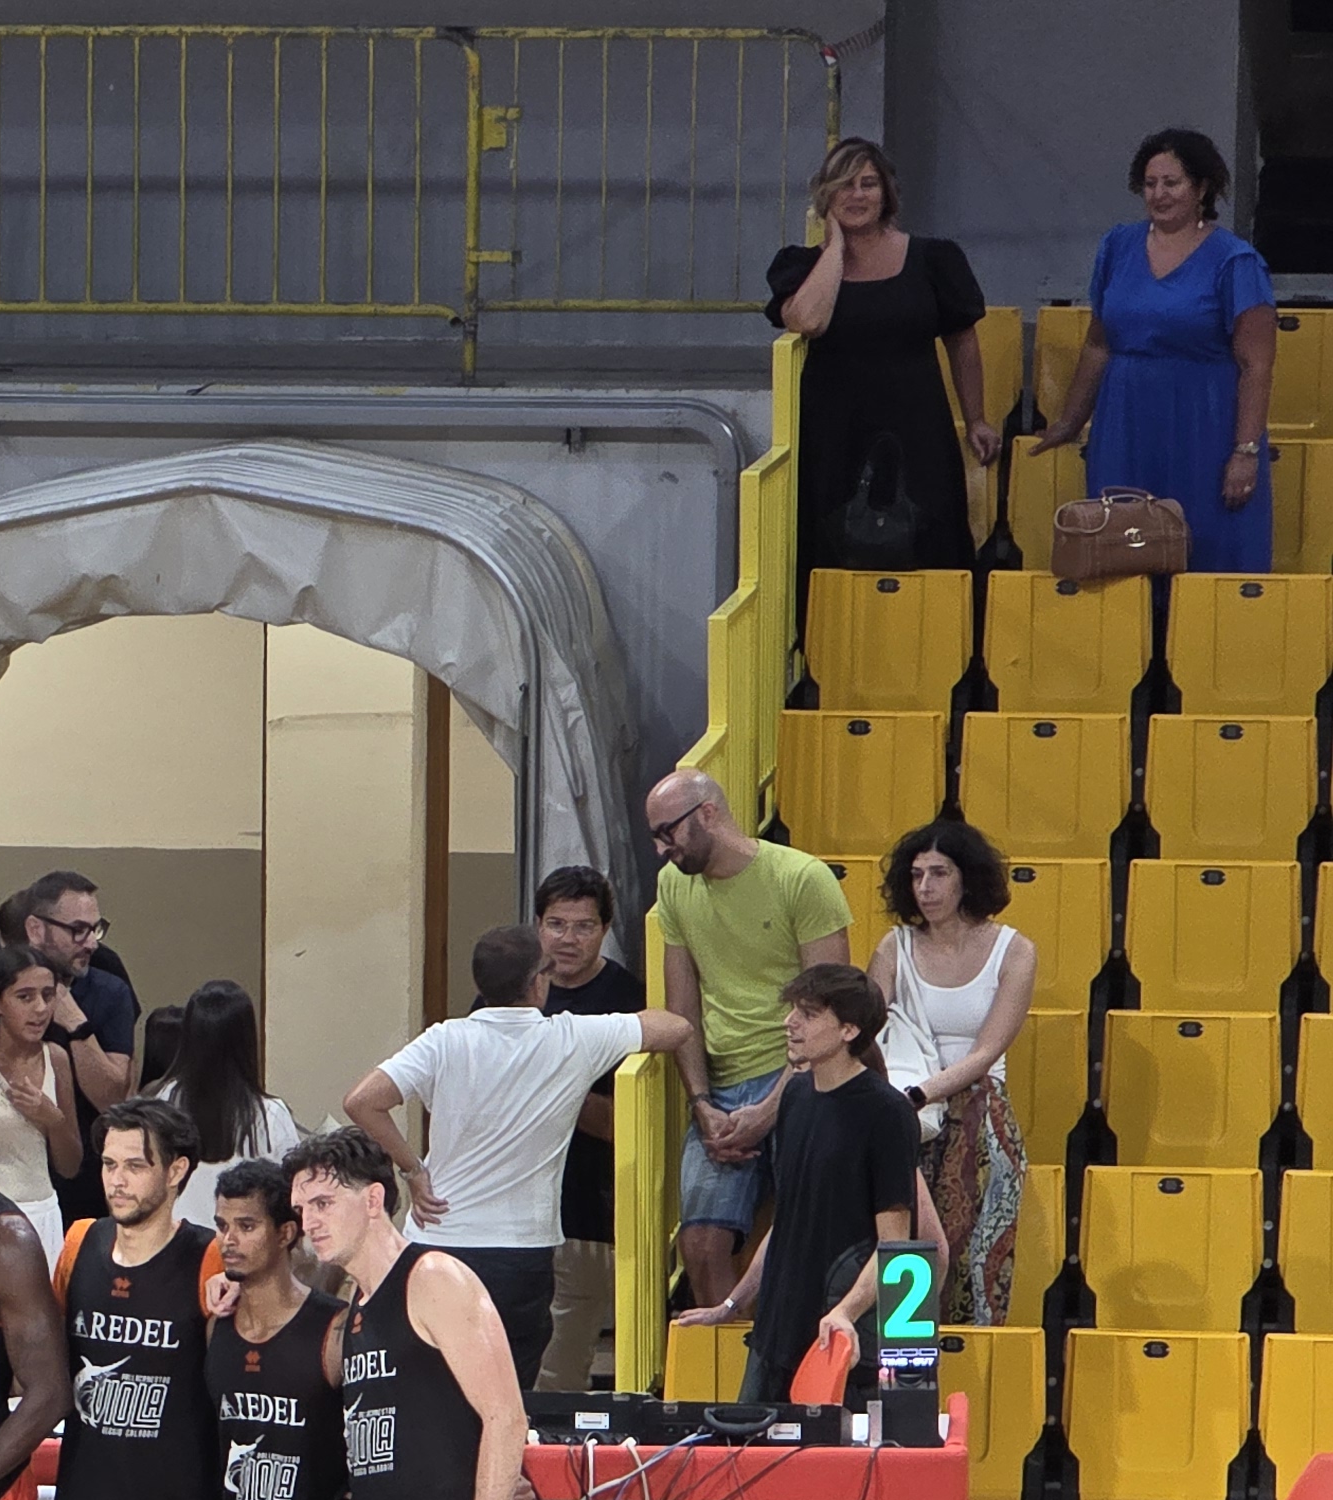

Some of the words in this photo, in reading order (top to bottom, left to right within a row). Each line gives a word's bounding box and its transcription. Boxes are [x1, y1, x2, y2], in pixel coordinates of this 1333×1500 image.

[882, 1253, 936, 1339] 2
[90, 1311, 181, 1350] REDEL
[91, 1379, 169, 1430] VIOLA
